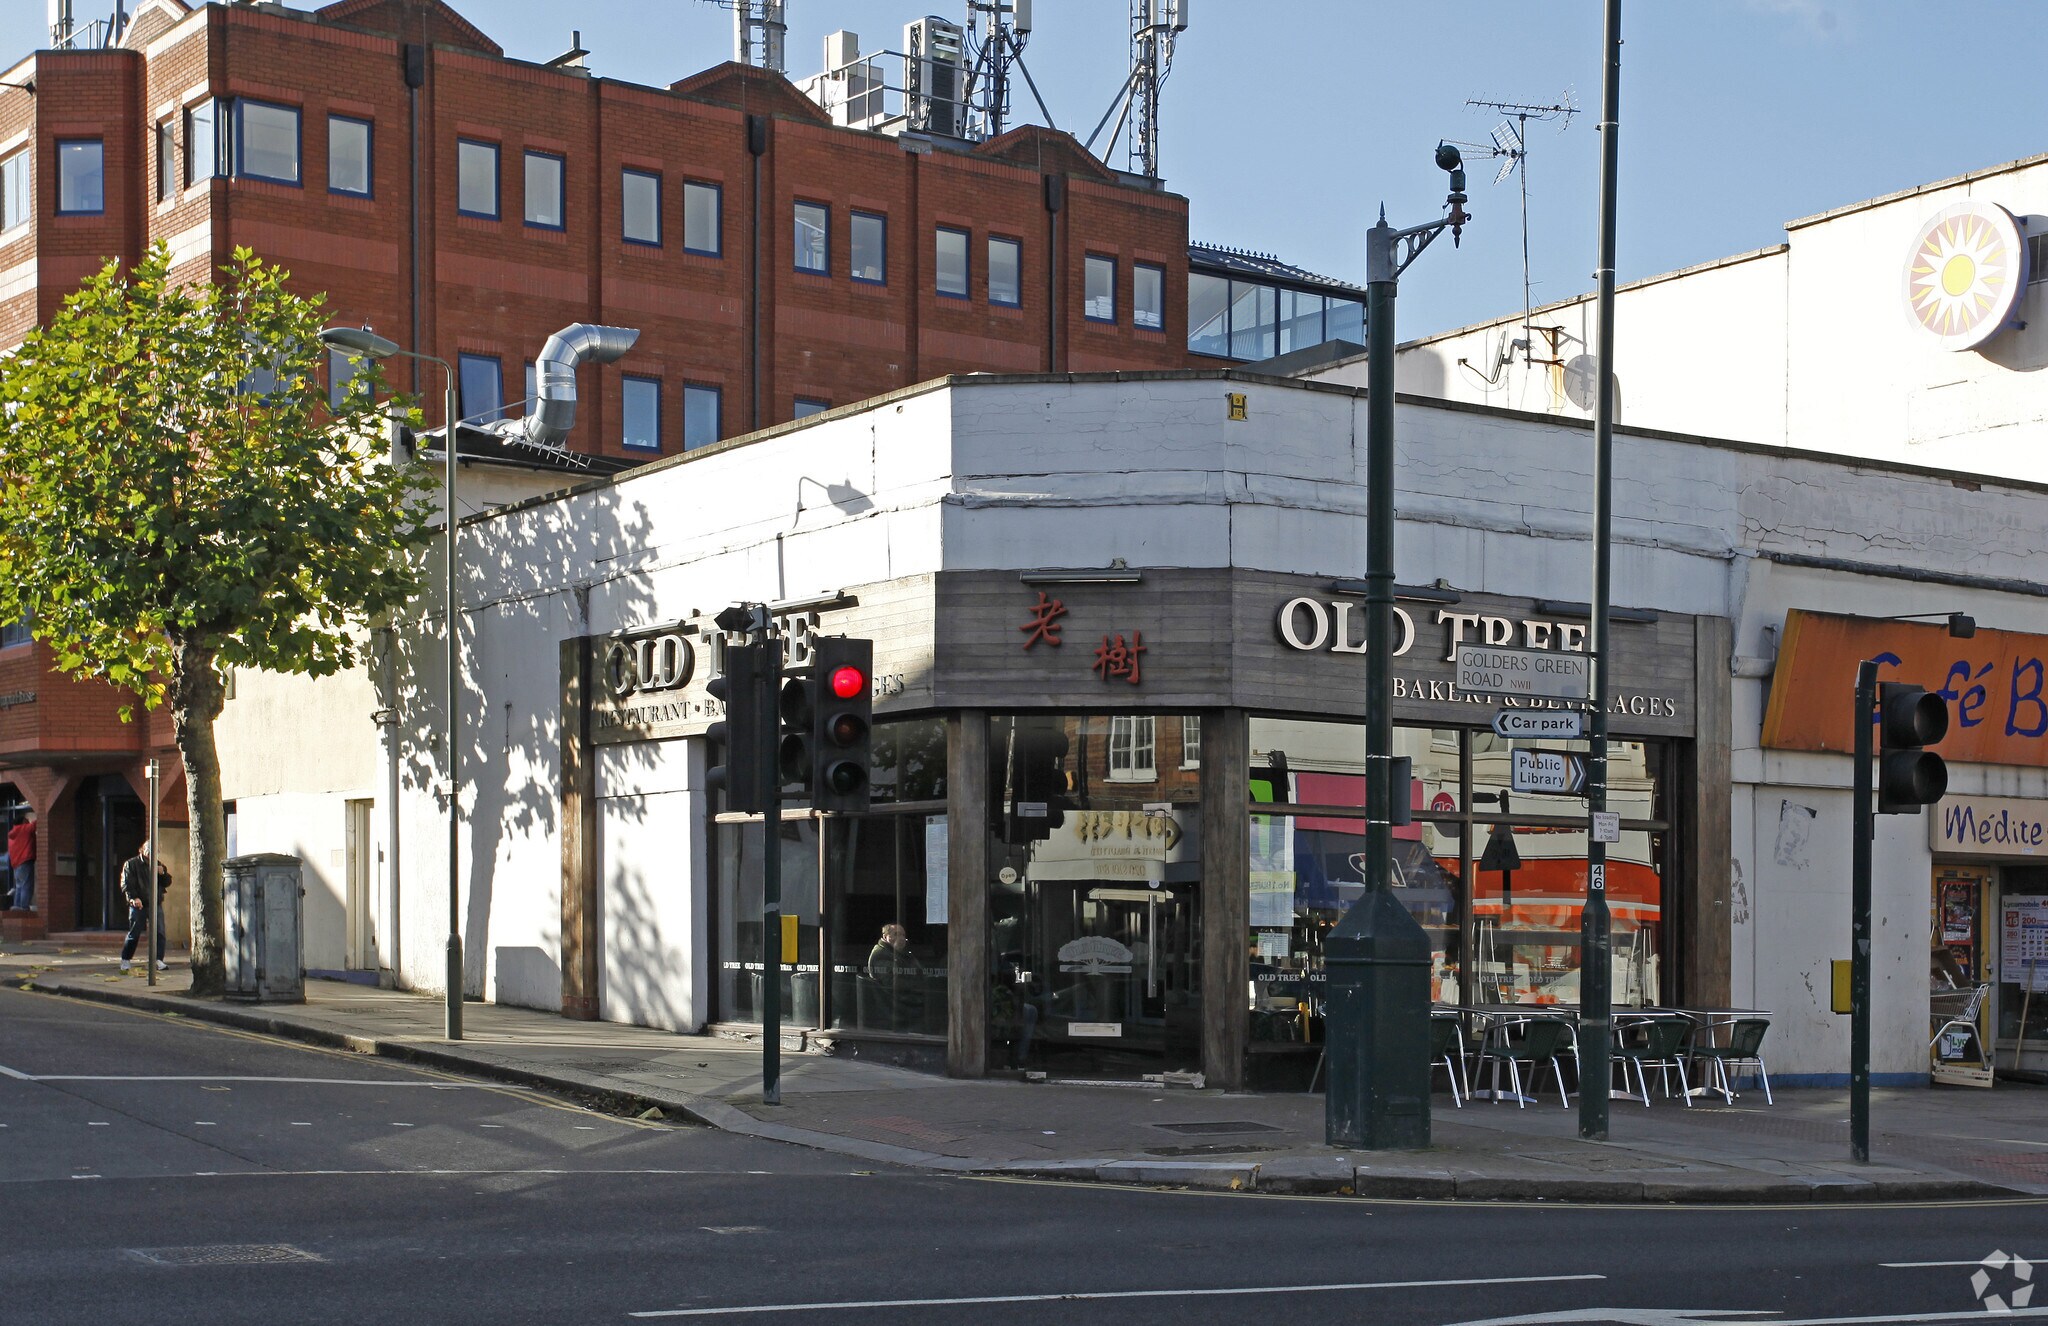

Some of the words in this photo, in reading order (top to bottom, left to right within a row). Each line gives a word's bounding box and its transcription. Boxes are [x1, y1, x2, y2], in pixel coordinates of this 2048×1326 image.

[603, 634, 696, 697] OLD
[1462, 652, 1529, 672] GOLDERS
[1534, 658, 1583, 675] GREEN
[1462, 670, 1504, 688] ROAD
[1867, 651, 1994, 728] Cfé
[1511, 716, 1538, 729] Car
[1541, 718, 1574, 731] park
[1520, 756, 1561, 771] Public
[1520, 772, 1565, 787] Library
[1945, 804, 2048, 846] Médite
[834, 965, 845, 973] OLD
[1258, 974, 1276, 982] OLD
[1277, 974, 1300, 982] TREE
